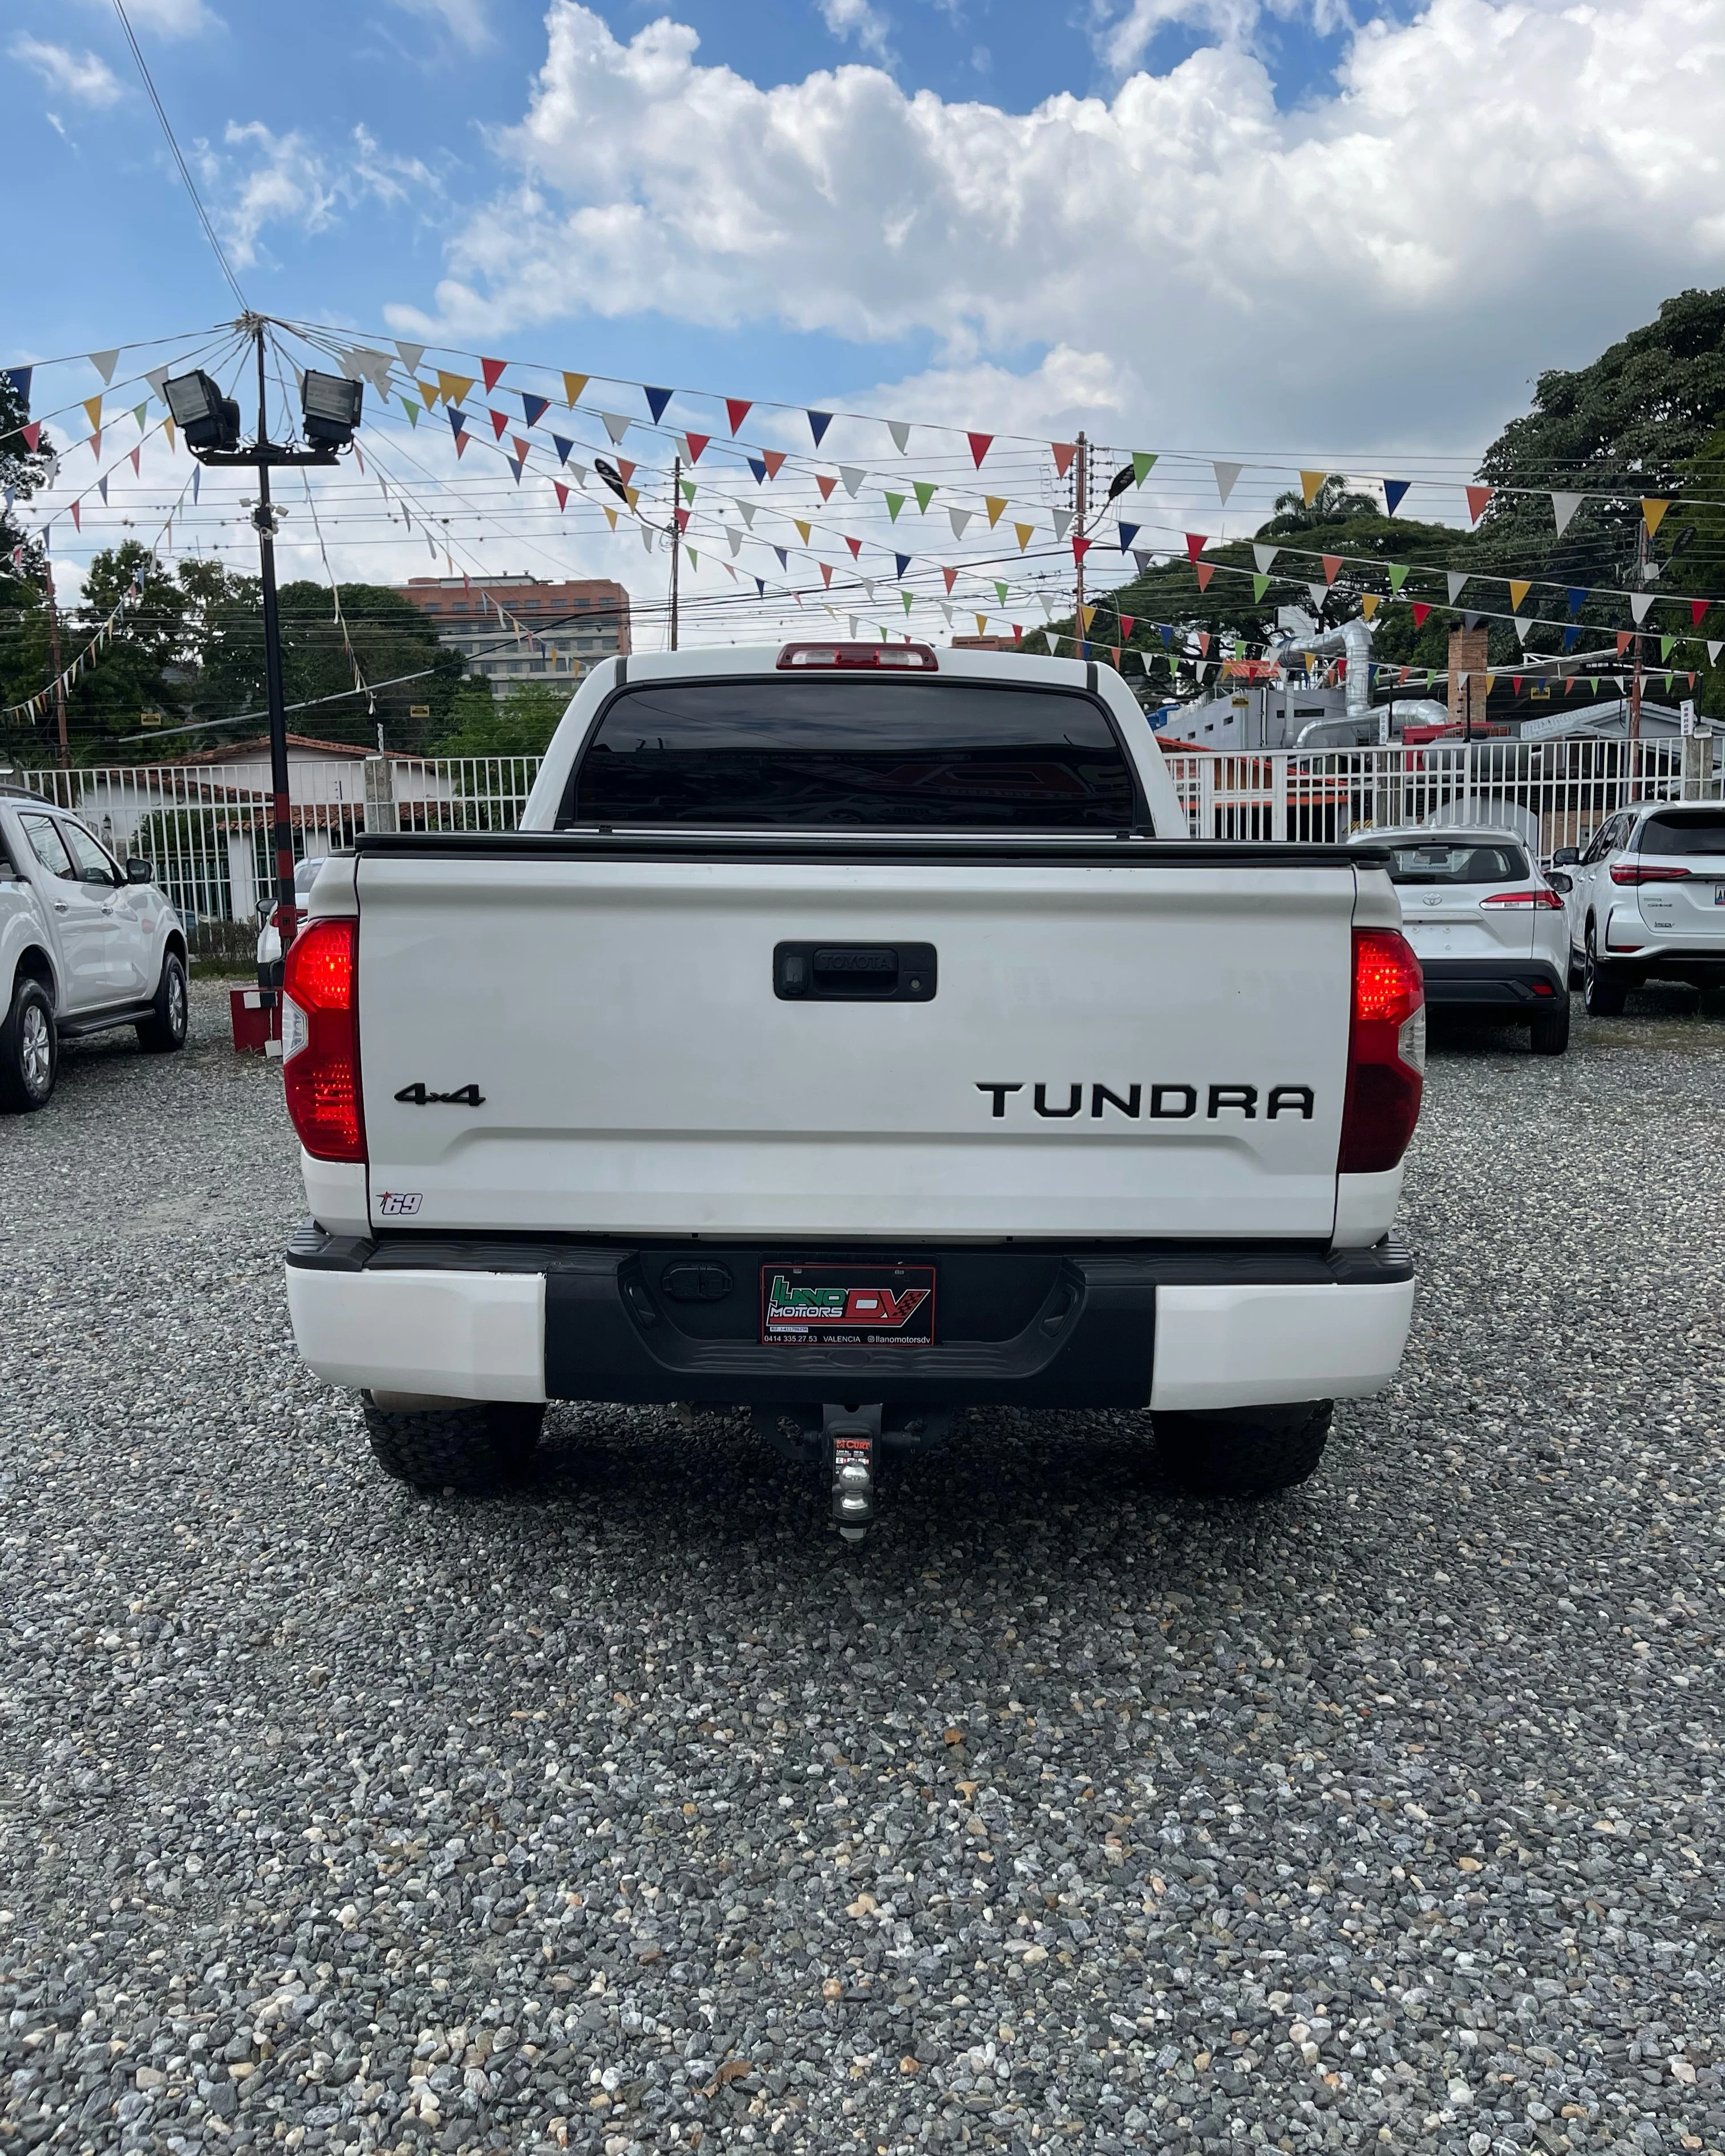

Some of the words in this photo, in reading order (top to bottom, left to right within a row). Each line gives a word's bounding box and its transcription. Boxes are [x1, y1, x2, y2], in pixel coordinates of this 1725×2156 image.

[820, 954, 891, 969] TOYOTA
[394, 1083, 486, 1106] 4x4
[974, 1083, 1315, 1120] TUNDRA
[382, 1193, 423, 1215] 69
[770, 1306, 843, 1318] MOTORS
[845, 1289, 931, 1319] DV
[876, 1335, 930, 1344] llanomotorsdv
